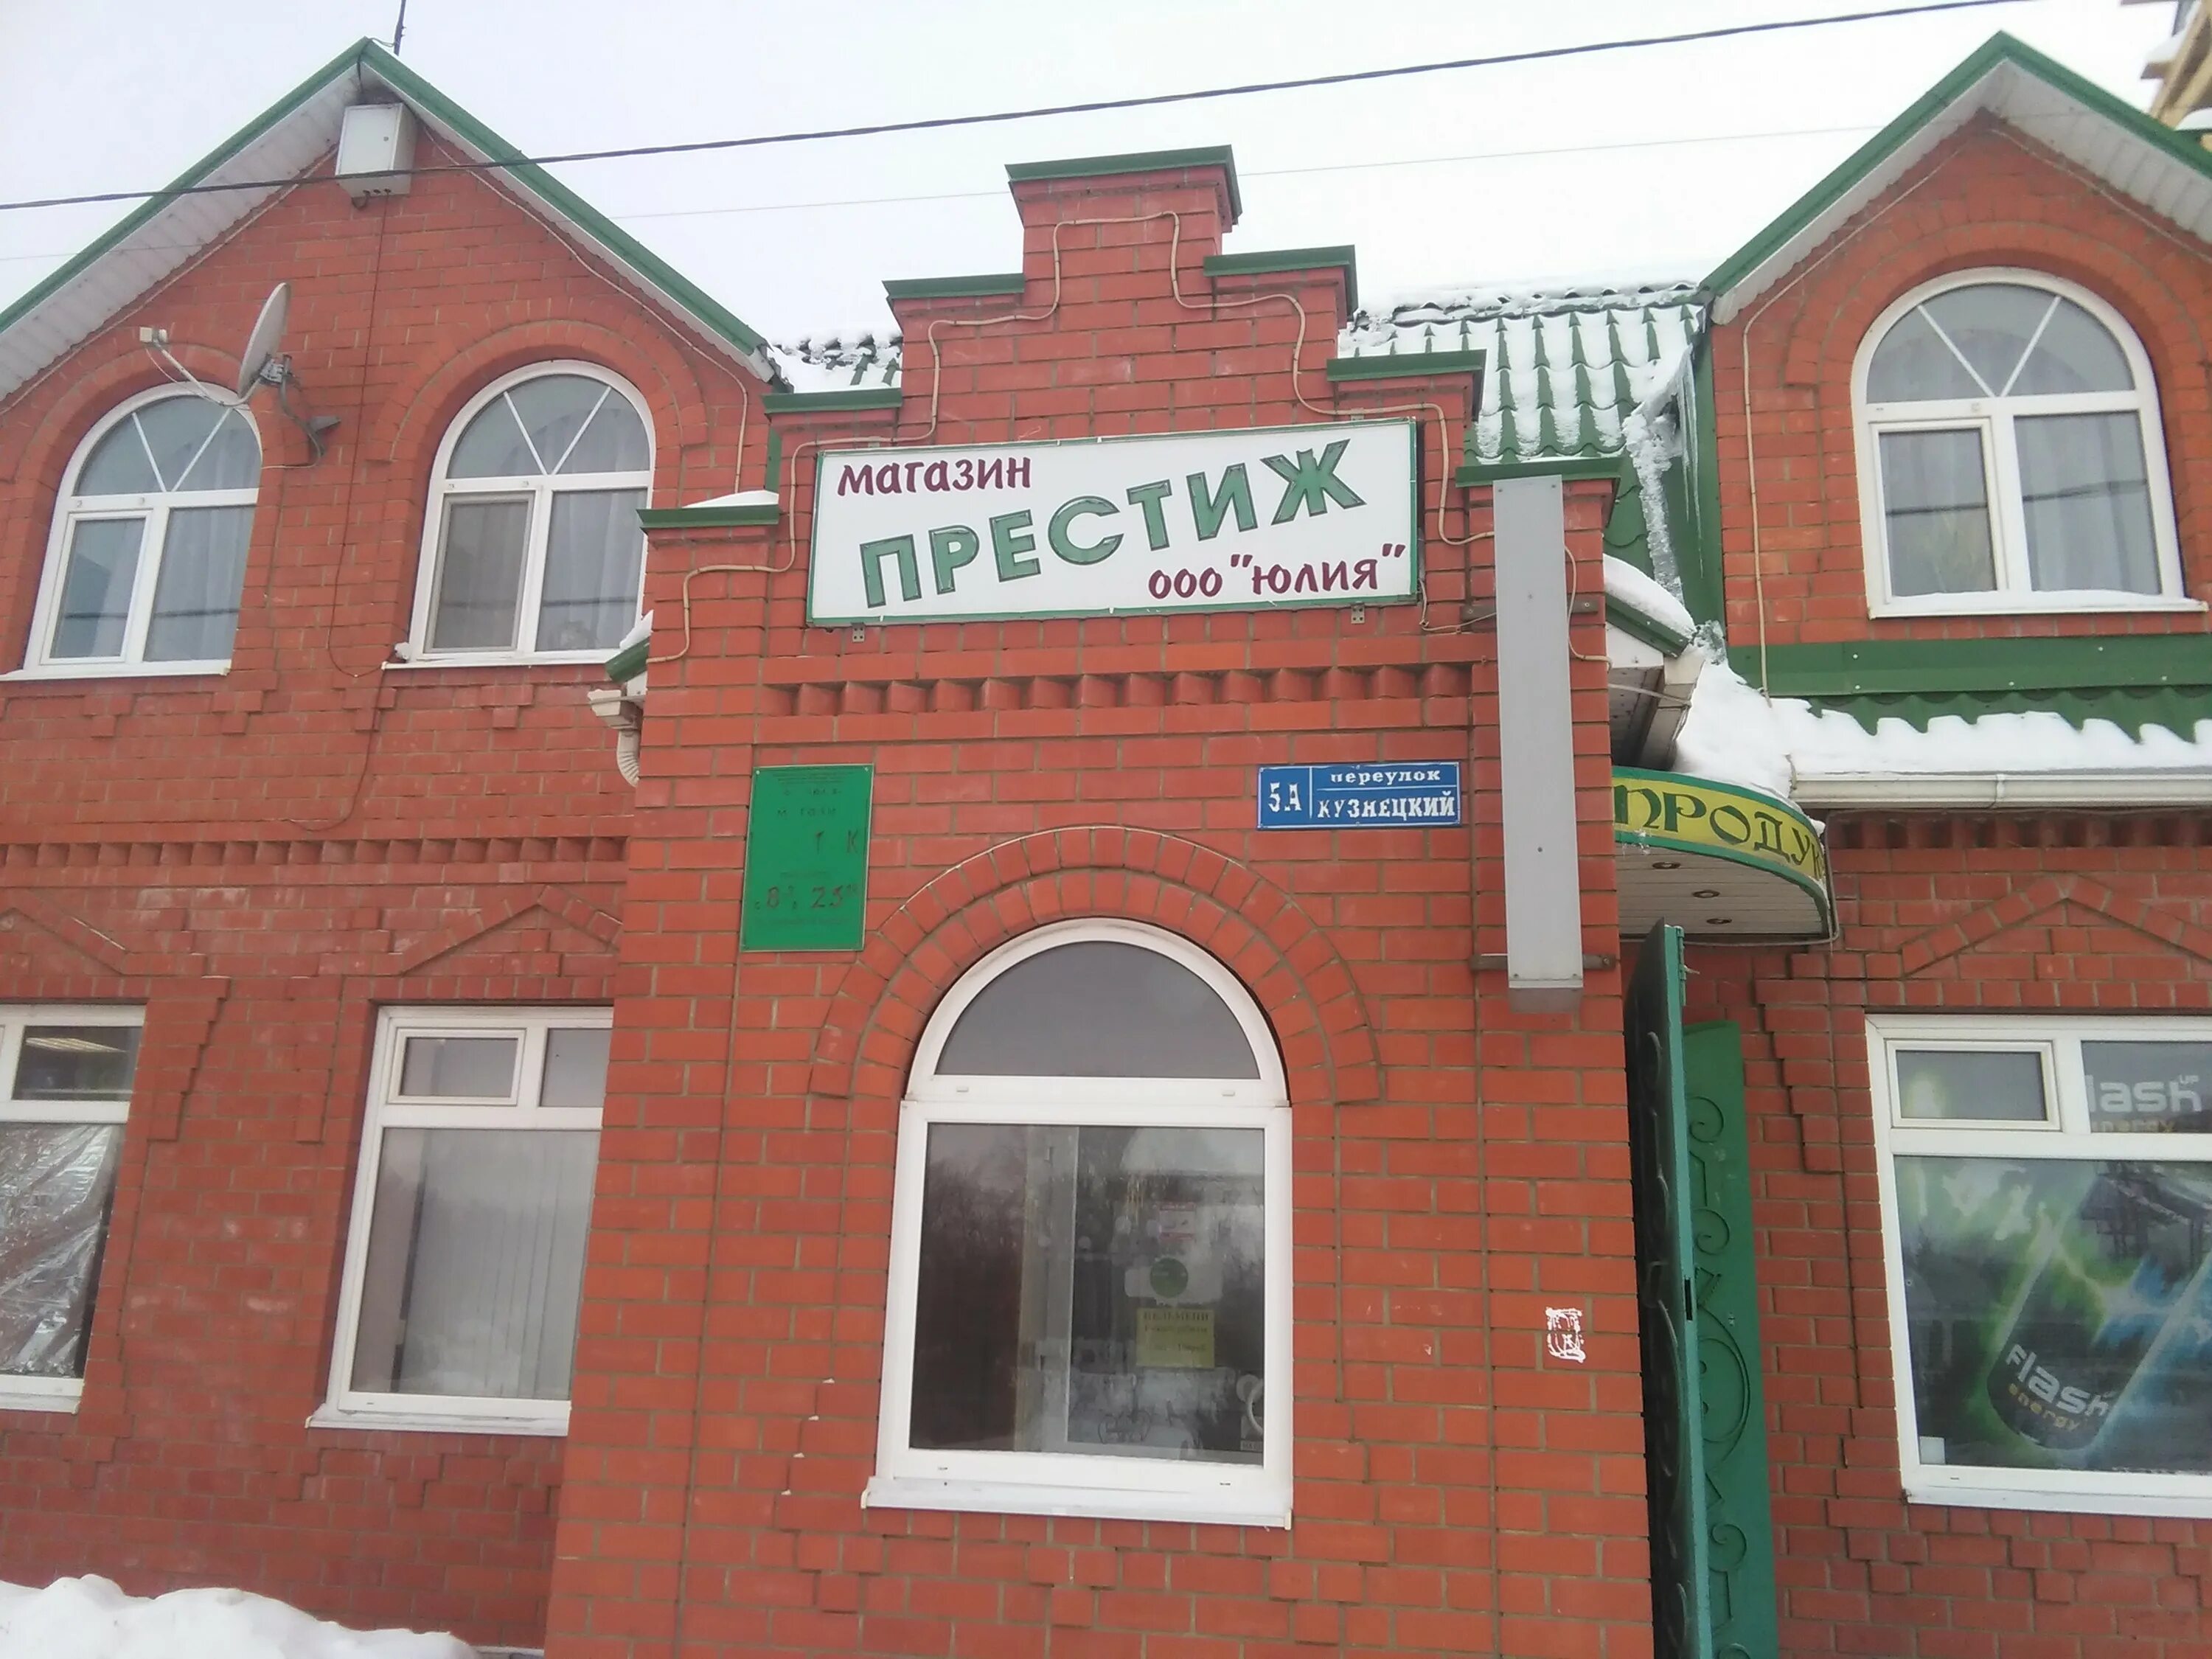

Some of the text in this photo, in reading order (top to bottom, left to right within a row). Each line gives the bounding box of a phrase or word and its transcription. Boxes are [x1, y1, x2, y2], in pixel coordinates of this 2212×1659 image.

[837, 456, 1032, 496] магазин
[860, 439, 1366, 608] ПРЕСТИЖ
[1268, 782, 1302, 812] 5А
[1330, 770, 1441, 786] переулок
[1317, 790, 1455, 821] КУЗНЕЦКИЙ
[2084, 1074, 2202, 1112] lash
[2005, 1343, 2109, 1417] Flash
